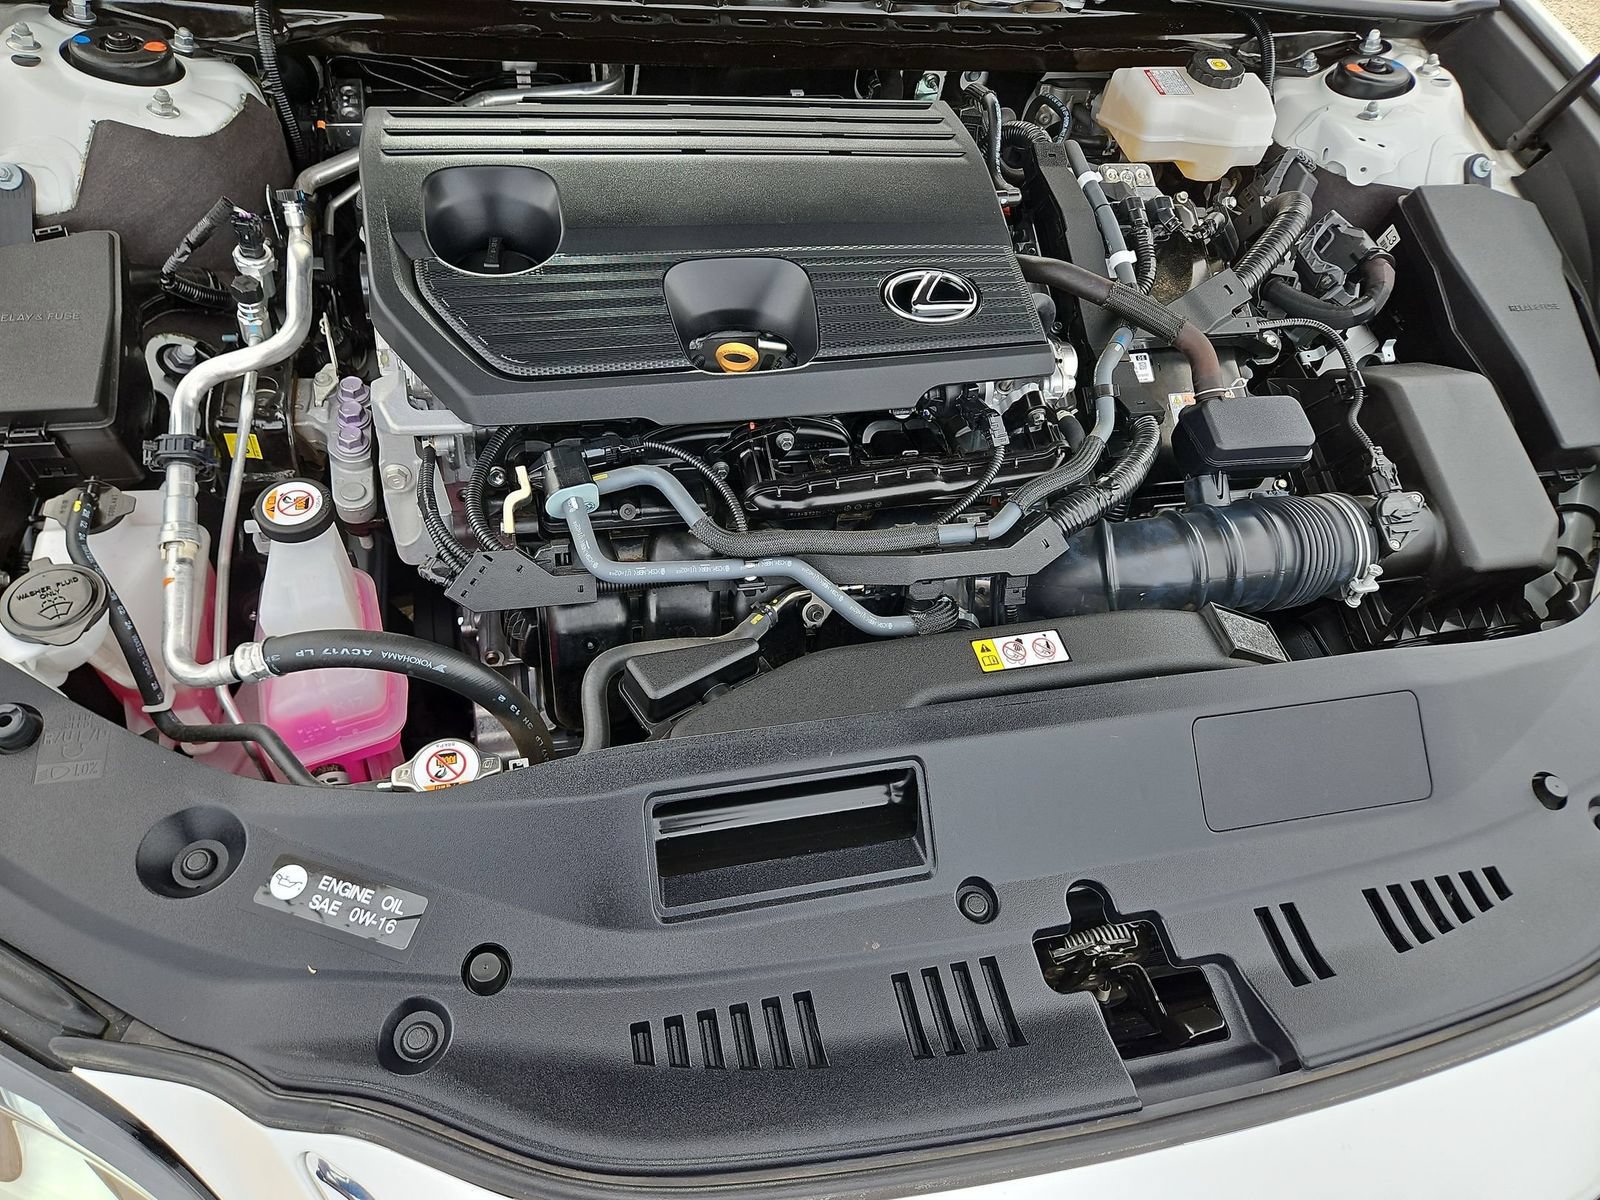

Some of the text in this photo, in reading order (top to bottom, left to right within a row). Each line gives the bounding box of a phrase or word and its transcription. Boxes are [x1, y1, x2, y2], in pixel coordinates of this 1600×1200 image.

[47, 311, 80, 321] FUSE
[16, 576, 79, 601] WASHER FLUID
[39, 588, 60, 600] ONLY
[295, 648, 314, 657] LP
[321, 648, 373, 657] ACV17
[381, 651, 433, 669] YOKOHAMA
[509, 704, 521, 716] 13
[318, 875, 404, 916] ENGINE OIL
[308, 894, 397, 934] SAE 0W-16
